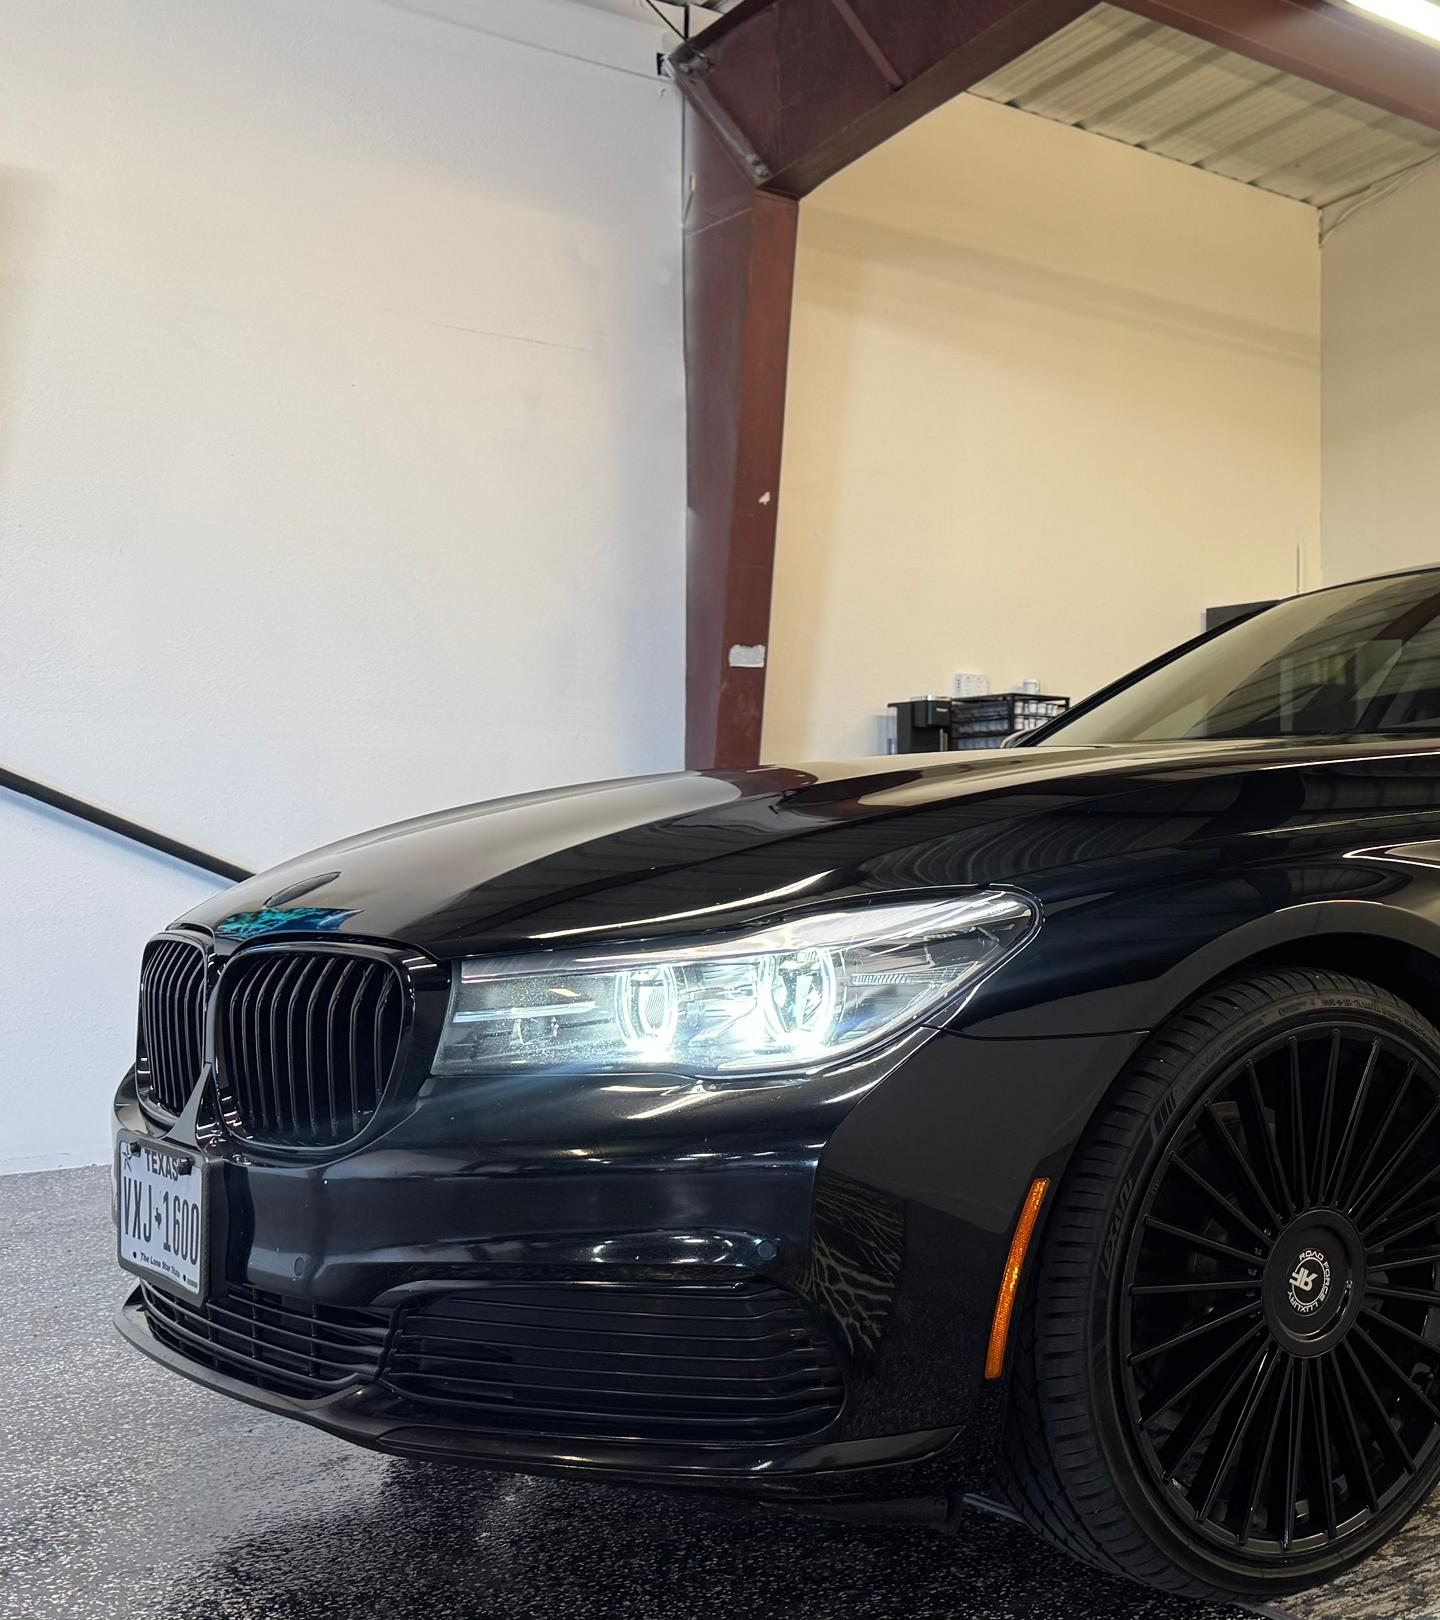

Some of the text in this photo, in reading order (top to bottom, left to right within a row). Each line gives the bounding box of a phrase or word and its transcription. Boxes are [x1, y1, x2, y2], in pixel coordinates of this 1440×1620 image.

[145, 1148, 179, 1182] TEXAS
[1298, 1249, 1331, 1302] ROAD FORCE
[1287, 1290, 1319, 1313] LUXURY
